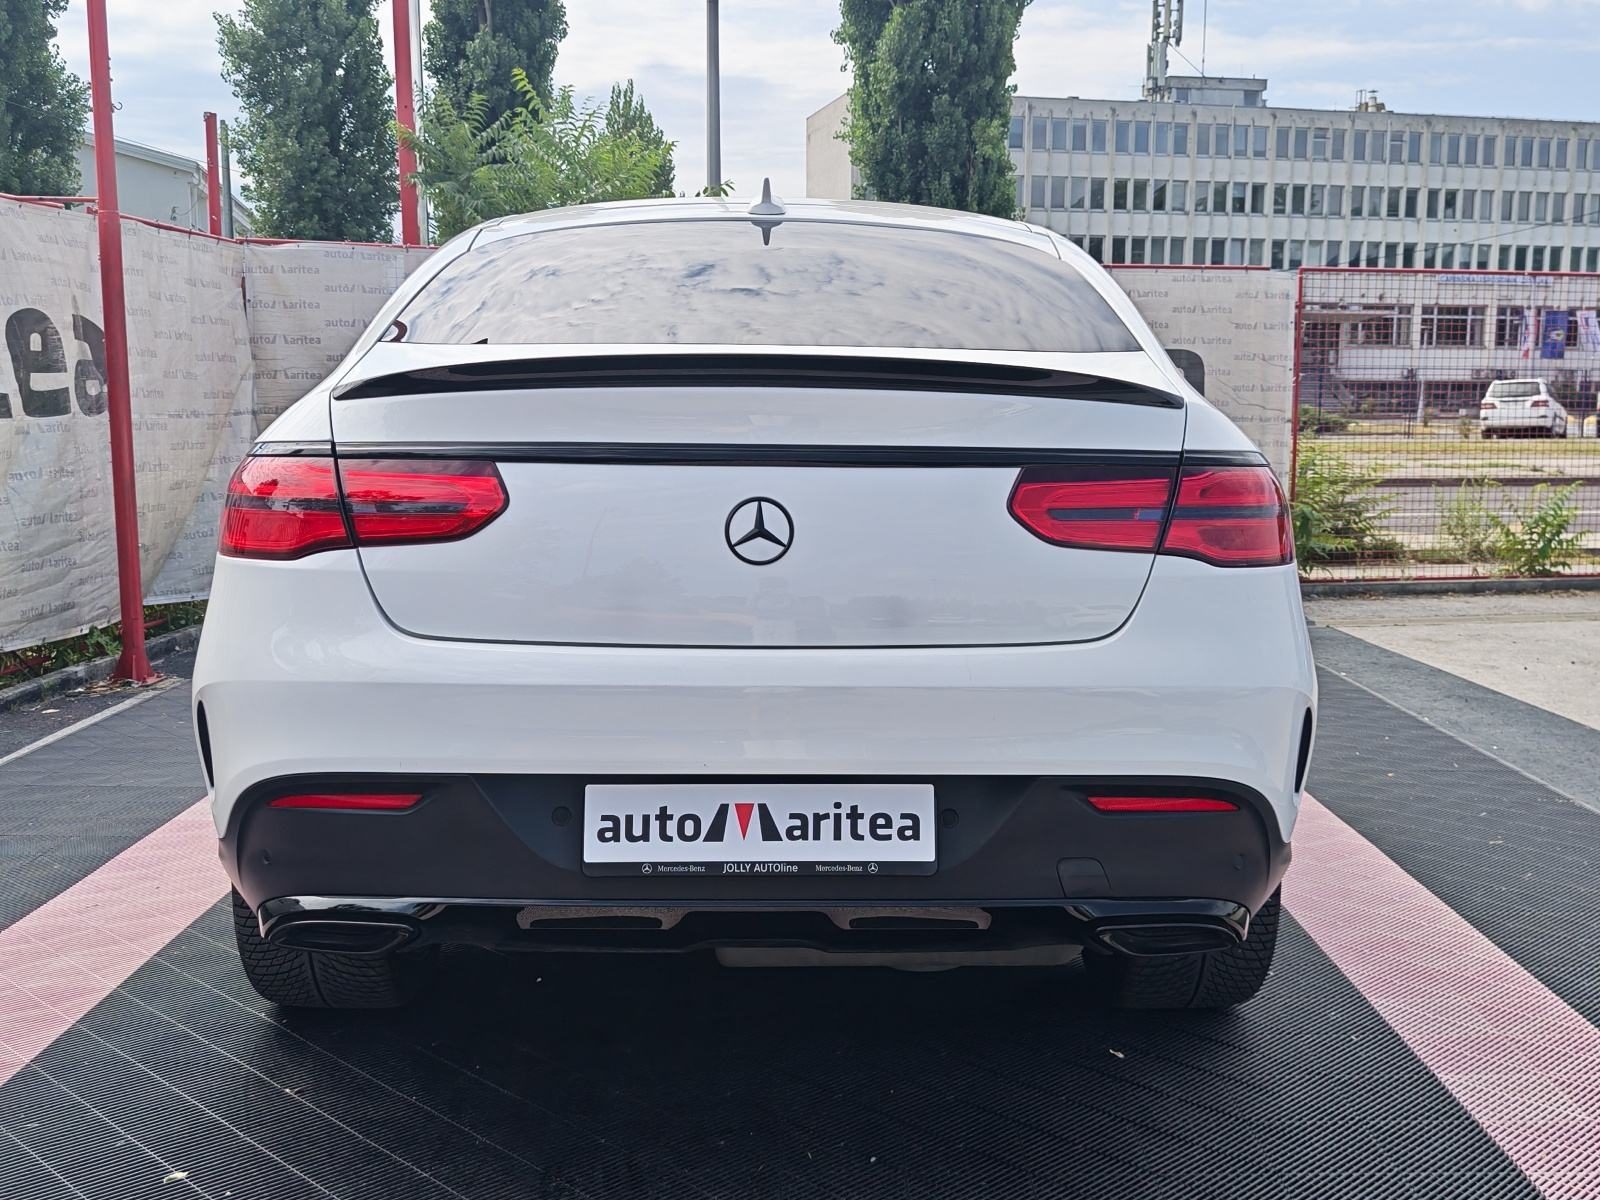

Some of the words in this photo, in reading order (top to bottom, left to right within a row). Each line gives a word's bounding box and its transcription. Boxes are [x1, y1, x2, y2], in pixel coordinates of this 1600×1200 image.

[0, 308, 107, 418] ea
[597, 801, 921, 843] autoMaritea
[657, 864, 706, 873] Mercedes-Benz
[723, 863, 751, 873] JOLLY
[754, 863, 799, 873] AUTOline
[815, 864, 863, 873] Mercedes-Benz
